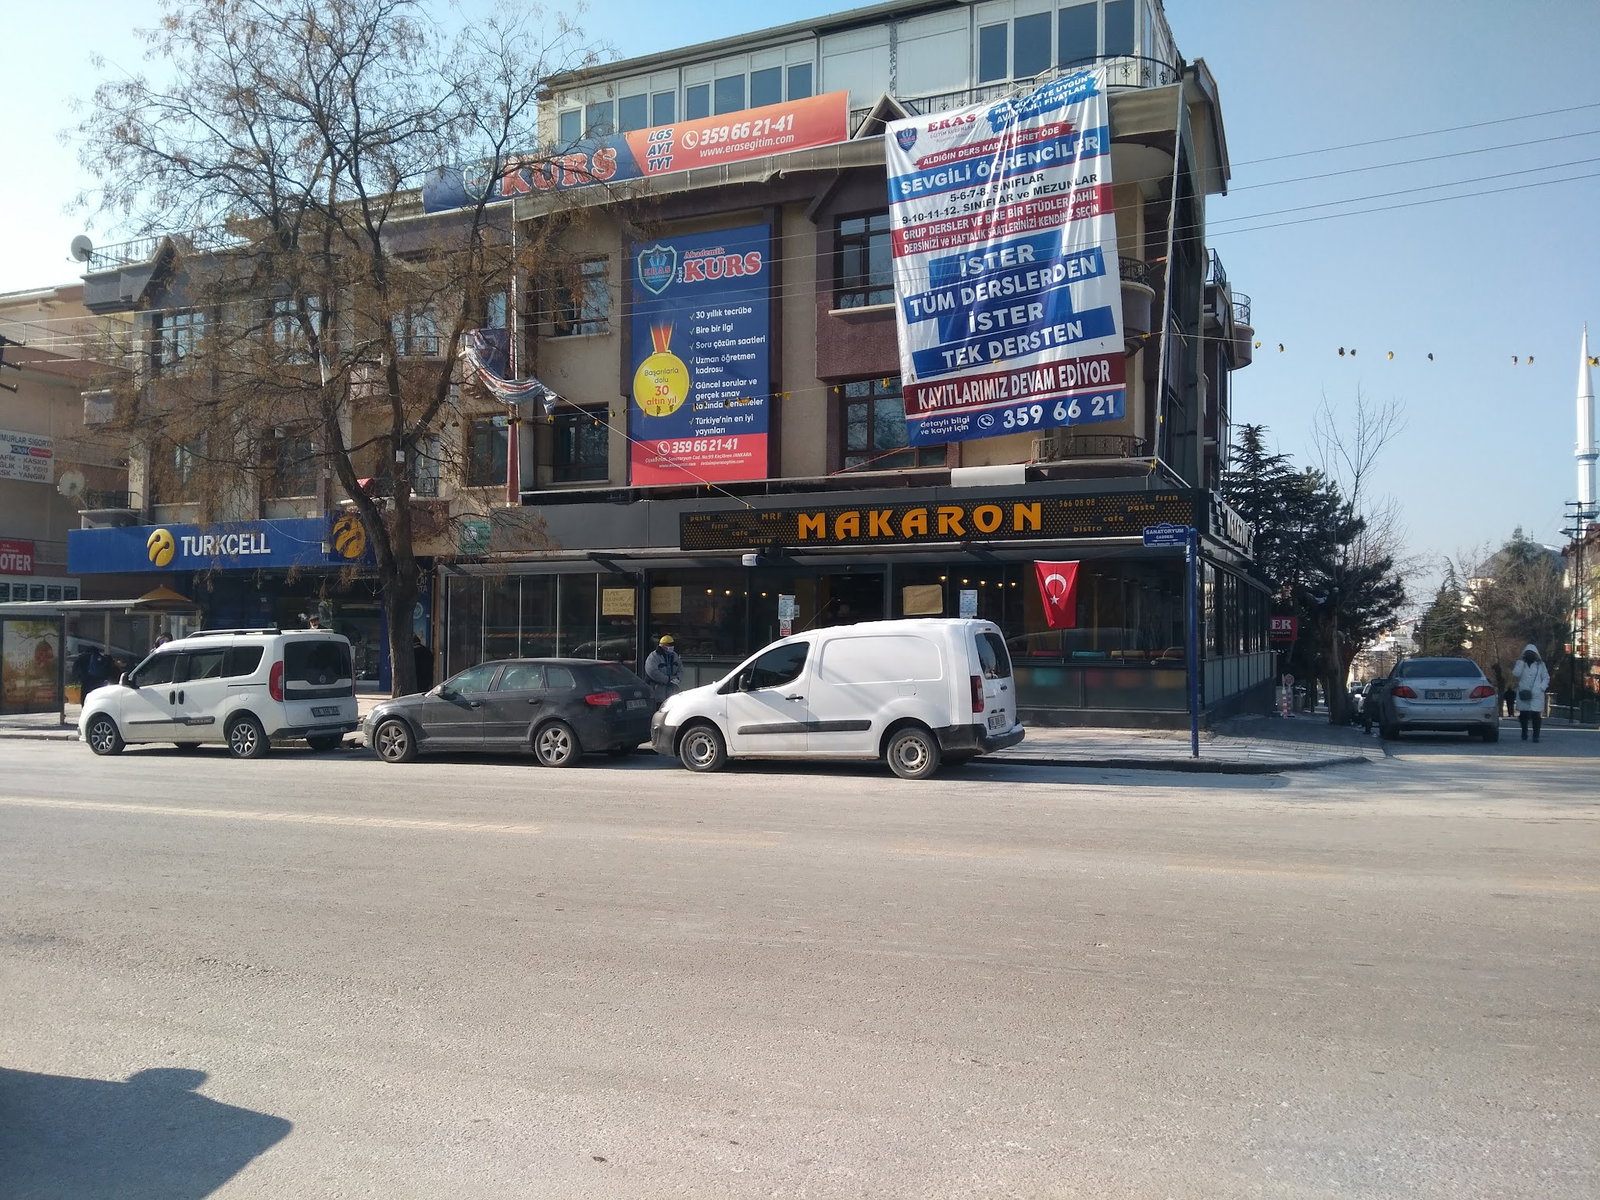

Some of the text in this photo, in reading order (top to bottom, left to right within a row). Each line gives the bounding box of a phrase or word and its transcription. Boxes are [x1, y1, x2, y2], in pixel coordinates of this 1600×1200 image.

[700, 113, 794, 146] 359 66 21-41
[928, 113, 976, 132] ERAS
[648, 128, 674, 142] LGS
[646, 141, 674, 157] AYT
[700, 133, 795, 158] www.erasegitim.com
[923, 152, 956, 166] ALDIĞIN
[958, 147, 980, 157] DERS
[1041, 126, 1060, 137] ÖDE
[648, 155, 673, 171] TYT
[901, 136, 1099, 194] SEVGİLİ ÖĞRENCİLER
[501, 148, 617, 197] KURS
[992, 173, 1044, 193] SINIFLAR
[1017, 191, 1030, 199] ve
[1033, 173, 1098, 195] MEZUNLAR
[902, 227, 927, 240] GRUP
[929, 219, 969, 235] DERSLER
[971, 215, 983, 226] VE
[1007, 205, 1024, 218] BİR
[1025, 197, 1069, 215] ETÜDLER
[1071, 187, 1099, 204] DAHİL
[904, 235, 939, 254] DERSİNİZİ
[941, 237, 950, 247] ve
[951, 229, 986, 245] HAFTALIK
[1075, 203, 1099, 219] SEÇİN
[683, 251, 762, 283] KURS
[960, 243, 1036, 278] İSTER
[910, 255, 1097, 318] TÜM DERSLERDEN
[696, 306, 752, 320] 30 yıllık tecrübe
[968, 302, 1044, 333] İSTER
[696, 323, 734, 334] Bire bir ilgi
[696, 335, 766, 349] Soru çözüm saatleri
[941, 319, 1084, 369] TEK DERSTEN
[695, 352, 756, 364] Uzman öğretmen
[695, 366, 724, 375] kadrosu
[654, 376, 669, 384] dolu
[695, 380, 721, 390] Güncel
[721, 379, 747, 388] sorular
[917, 357, 1111, 410] KAYITLARIMIZ DEVAM EDİYOR
[655, 385, 669, 396] 30
[695, 391, 720, 401] gerçek
[646, 396, 677, 406] altın yıl
[1003, 395, 1115, 429] 359 66 21
[695, 416, 733, 426] Türkiye'nin
[920, 415, 970, 429] detaylı bilgi
[695, 426, 726, 437] yayınları
[920, 423, 969, 436] ve kayıt için
[672, 438, 738, 454] 359 66 21-41
[1127, 504, 1156, 512] pasta
[797, 502, 1042, 541] MAKARON
[1073, 525, 1102, 533] bistro
[180, 532, 271, 557] TURKCELL
